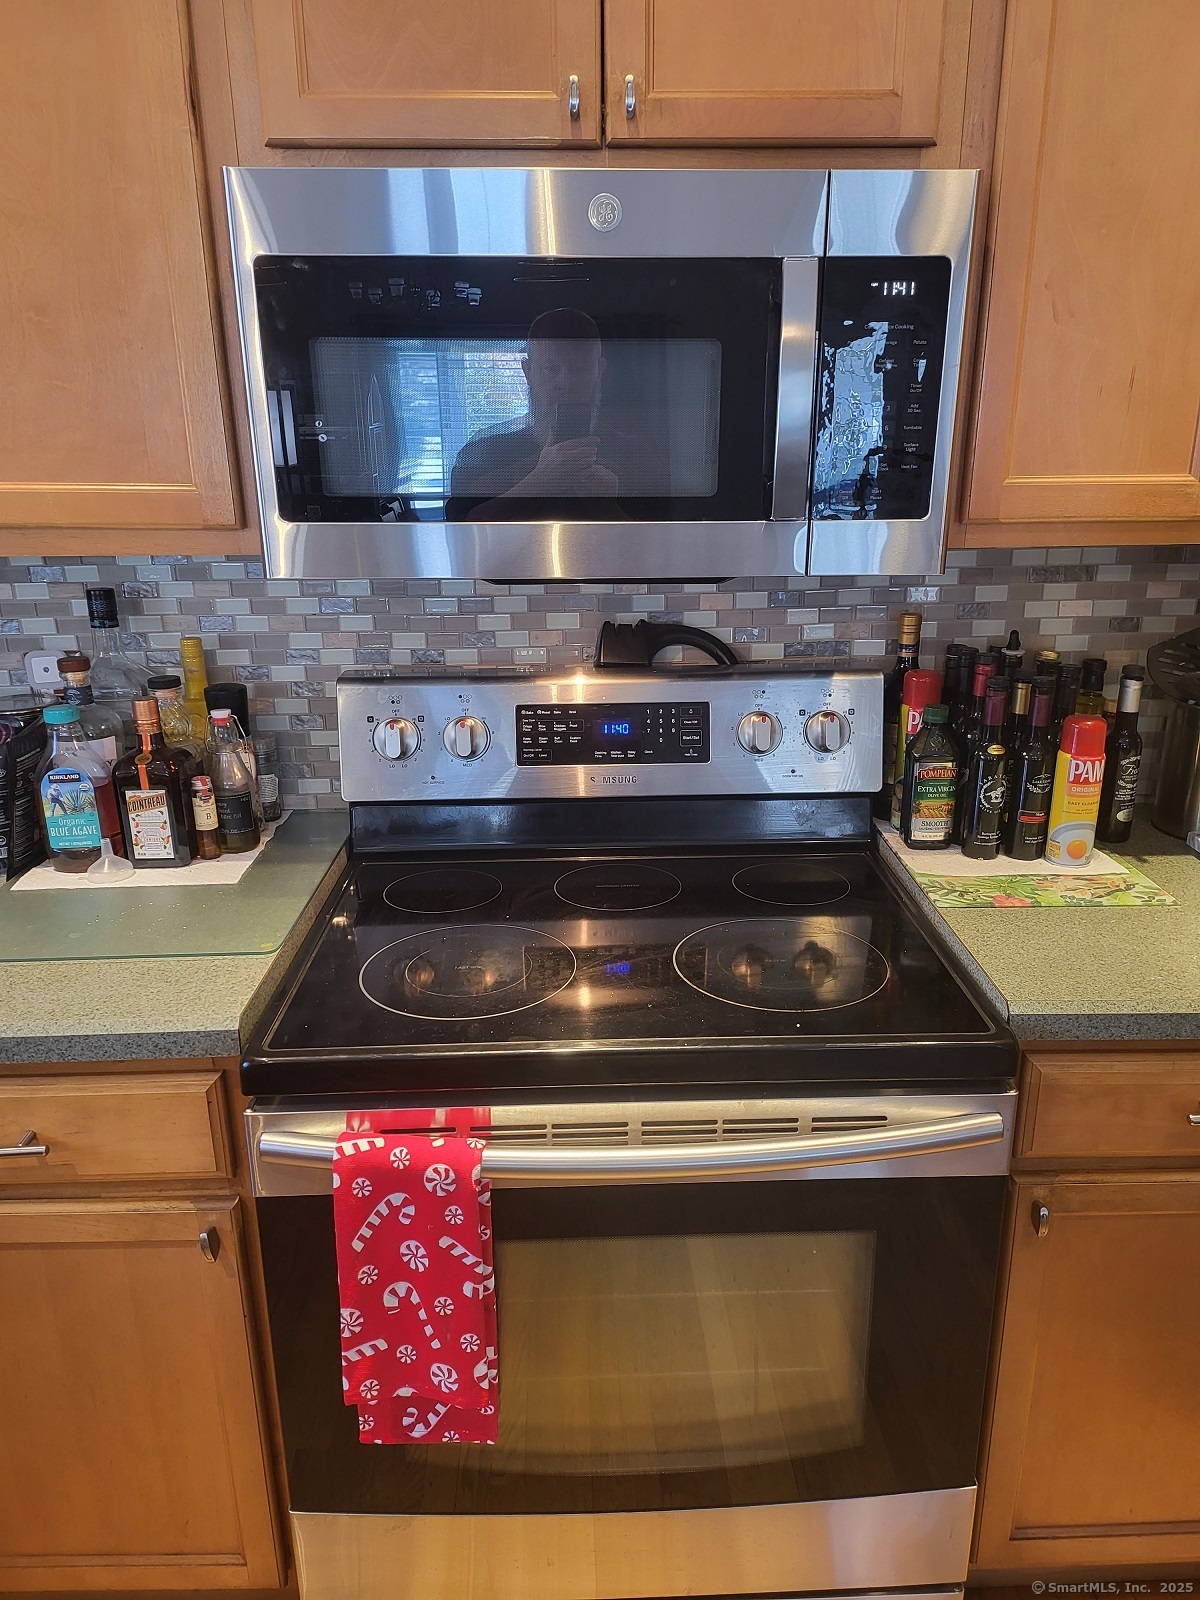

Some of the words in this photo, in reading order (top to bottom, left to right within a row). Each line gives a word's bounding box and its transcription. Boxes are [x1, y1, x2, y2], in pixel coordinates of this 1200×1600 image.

[604, 723, 629, 734] 11:40
[920, 768, 957, 779] POMPEIAN
[590, 776, 638, 784] SMSUNG
[917, 785, 937, 793] EXTRA
[128, 793, 166, 813] COINTREAU
[206, 812, 212, 820] B
[58, 817, 87, 827] Organic
[50, 826, 71, 837] BLUE
[72, 825, 98, 836] AGAVE
